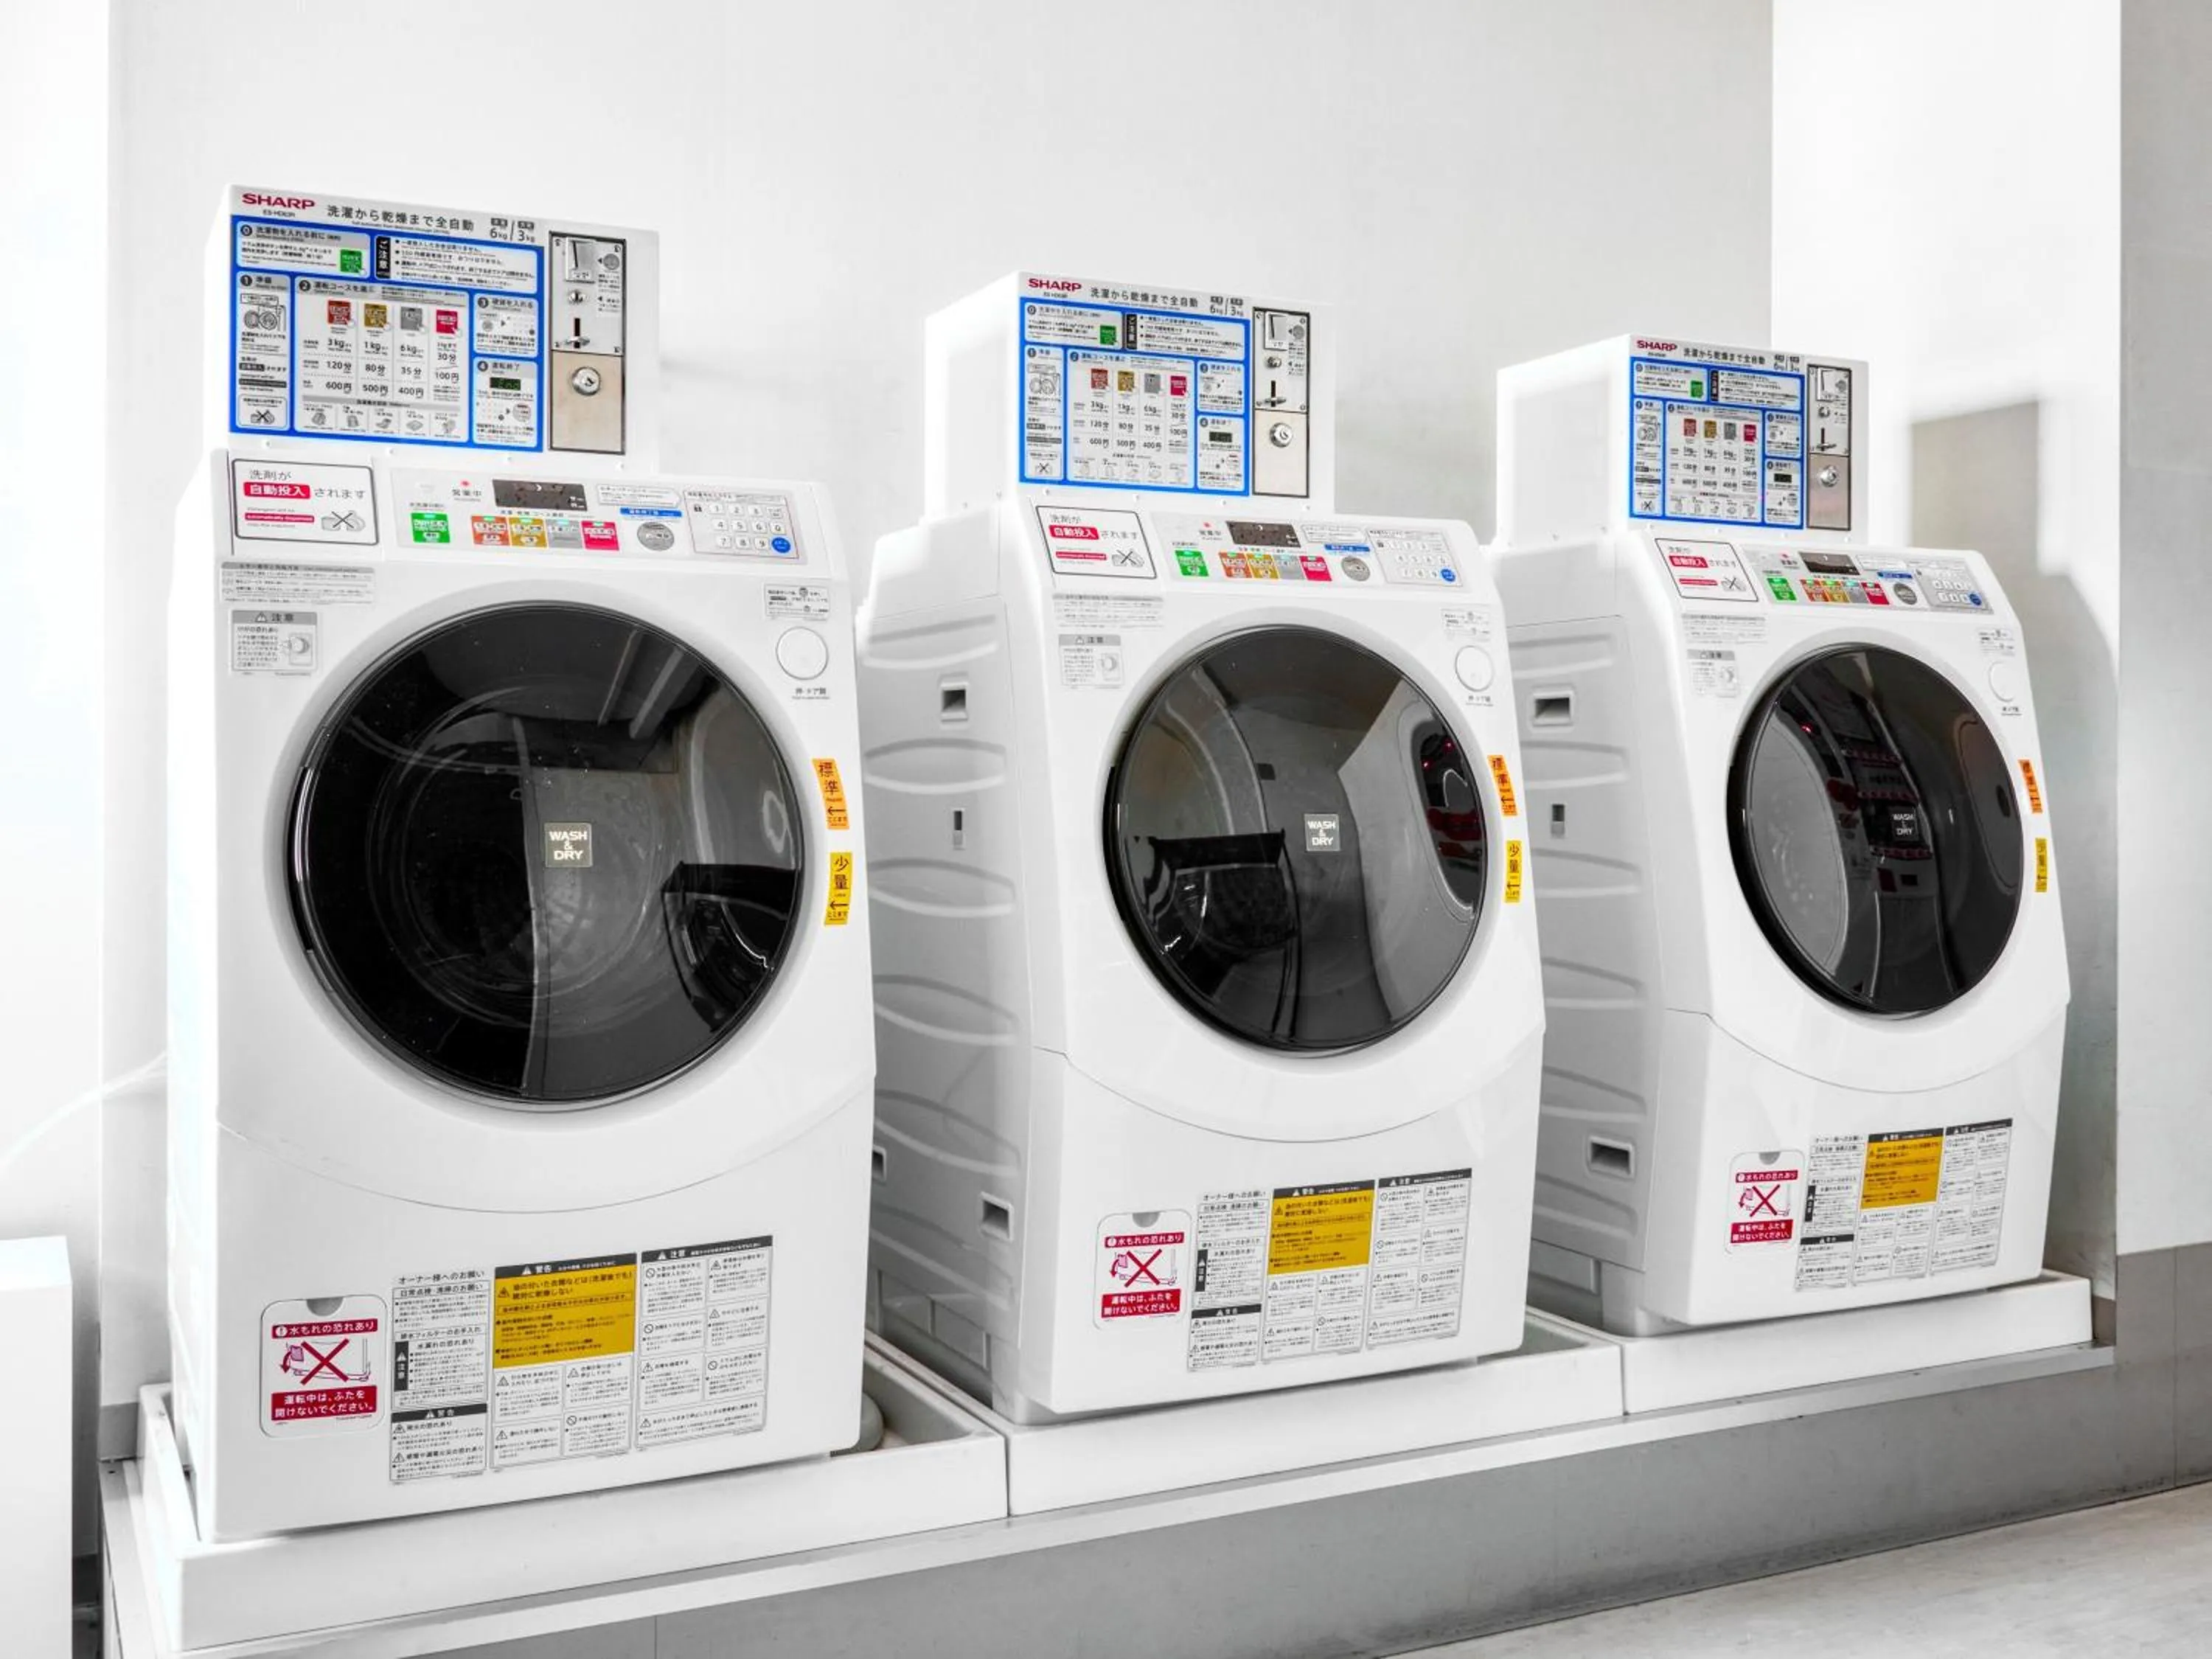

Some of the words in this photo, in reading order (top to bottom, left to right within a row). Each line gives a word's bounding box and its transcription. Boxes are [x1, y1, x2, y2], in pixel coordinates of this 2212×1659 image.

[242, 193, 315, 209] SHARP
[327, 205, 474, 231] 洗濯から乾燥まで全自動
[1029, 278, 1082, 291] SHARP
[1637, 340, 1677, 351] SHARP
[250, 470, 292, 481] 洗剤が
[250, 484, 306, 496] 自動投入
[314, 487, 366, 498] されます
[1307, 821, 1336, 830] WASH
[549, 831, 588, 841] WASH
[1312, 837, 1334, 846] DRY
[564, 841, 574, 850] &
[554, 850, 584, 860] DRY
[835, 855, 849, 890] 少量
[1118, 1235, 1183, 1246] 水もれの恐れあり
[289, 1321, 374, 1335] 水もれの恐れあり
[285, 1390, 365, 1405] 運転中は、ふたを
[275, 1402, 373, 1417] 開けないでください。
